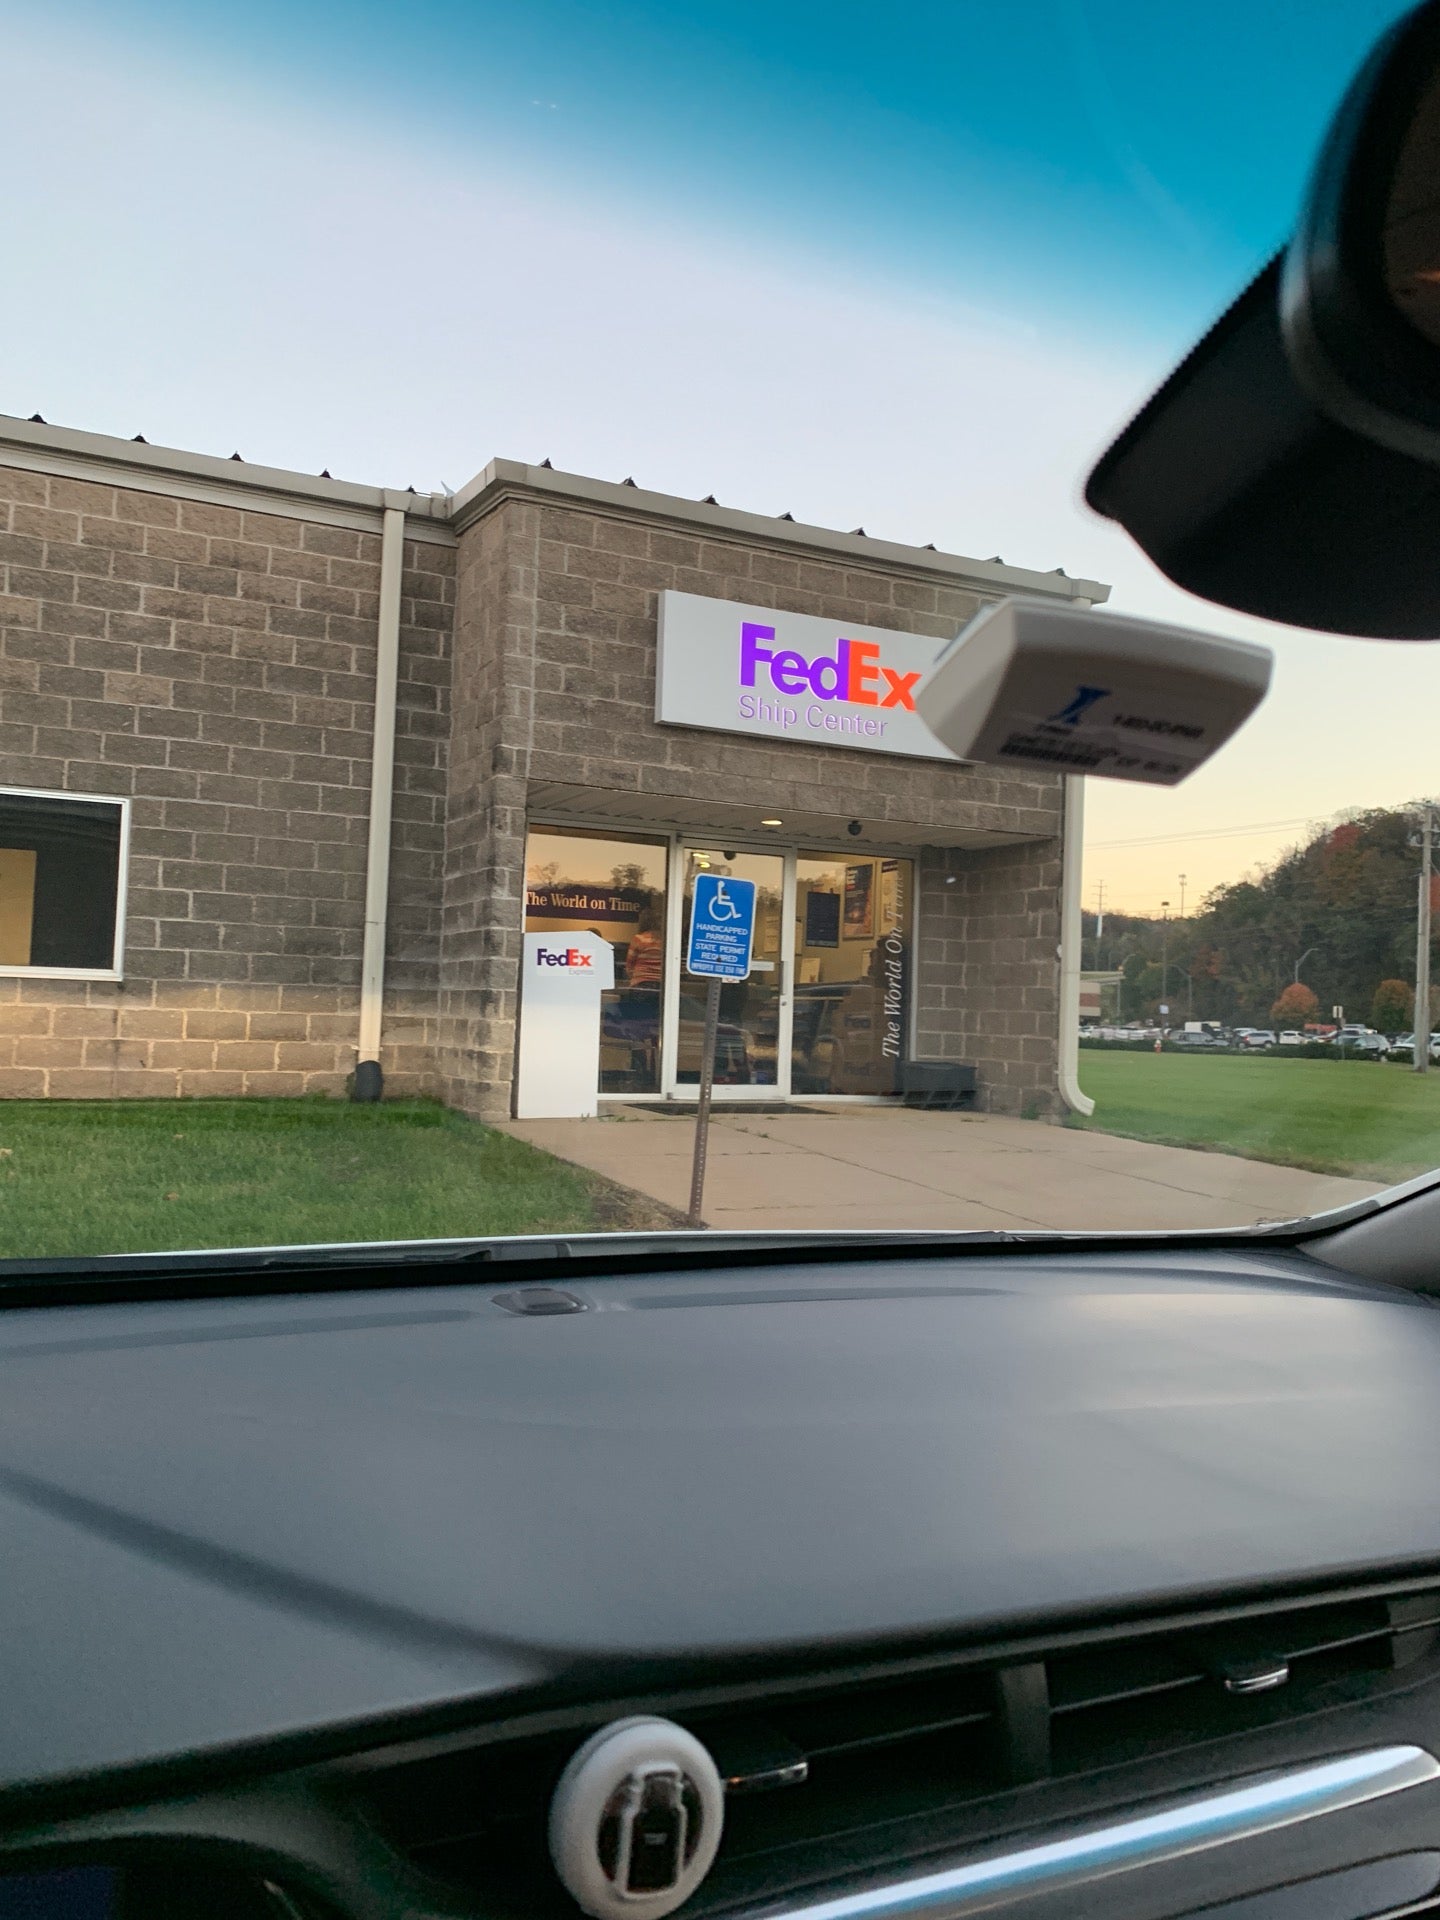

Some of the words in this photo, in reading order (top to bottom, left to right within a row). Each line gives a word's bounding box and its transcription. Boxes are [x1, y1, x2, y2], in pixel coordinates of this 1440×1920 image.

[739, 621, 922, 713] FedEx
[739, 694, 797, 729] Ship
[806, 704, 888, 737] Center
[526, 891, 548, 906] The
[551, 893, 587, 909] World
[590, 899, 606, 910] on
[609, 898, 640, 912] Time
[696, 923, 748, 935] HANDICAPPED
[706, 933, 737, 942] PARKING
[885, 925, 904, 955] On
[537, 948, 592, 967] FedEx
[695, 943, 717, 952] STATE
[719, 945, 746, 955] PERMIT
[884, 959, 903, 1017] World
[882, 1021, 901, 1058] The
